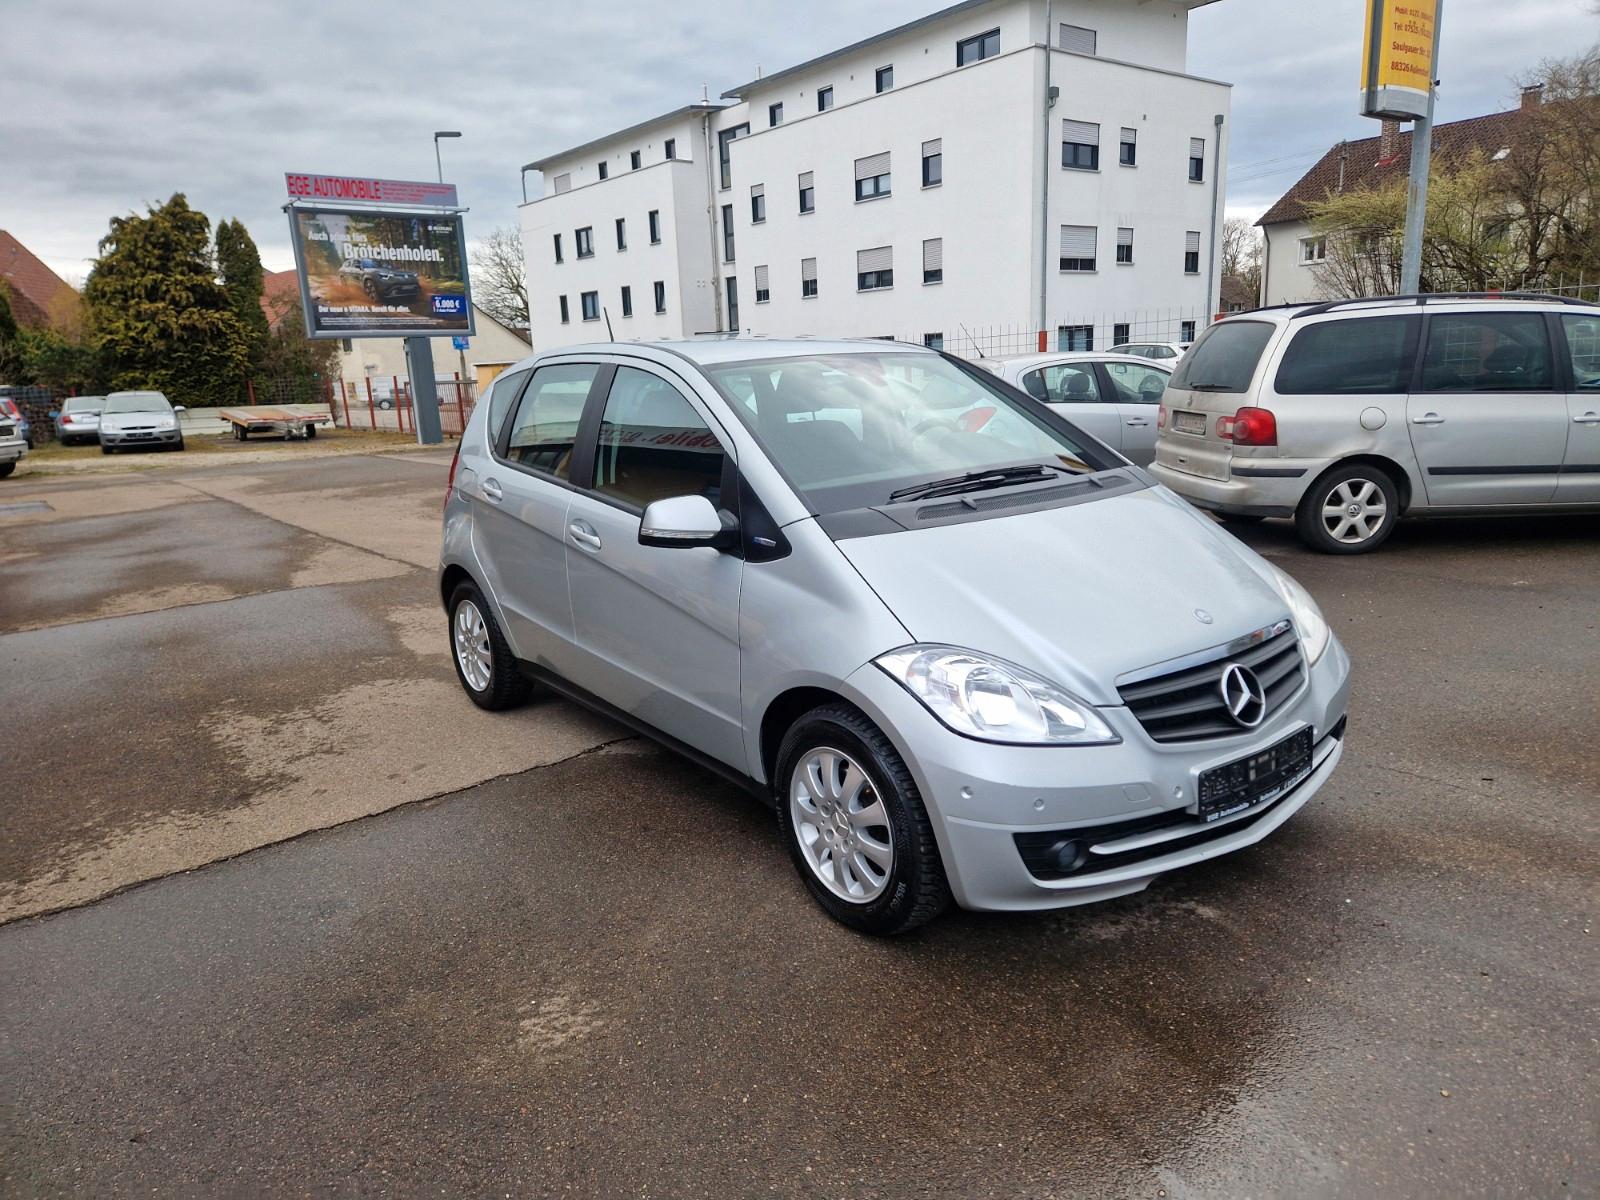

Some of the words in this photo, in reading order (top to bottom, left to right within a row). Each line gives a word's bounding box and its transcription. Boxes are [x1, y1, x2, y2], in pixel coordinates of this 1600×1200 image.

[1392, 41, 1419, 54] Saulgauer
[1391, 61, 1410, 73] 88326
[287, 175, 311, 195] EGE
[313, 176, 382, 199] AUTOMOBILE
[308, 230, 329, 241] Auch
[343, 242, 445, 262] Brötchenholen.
